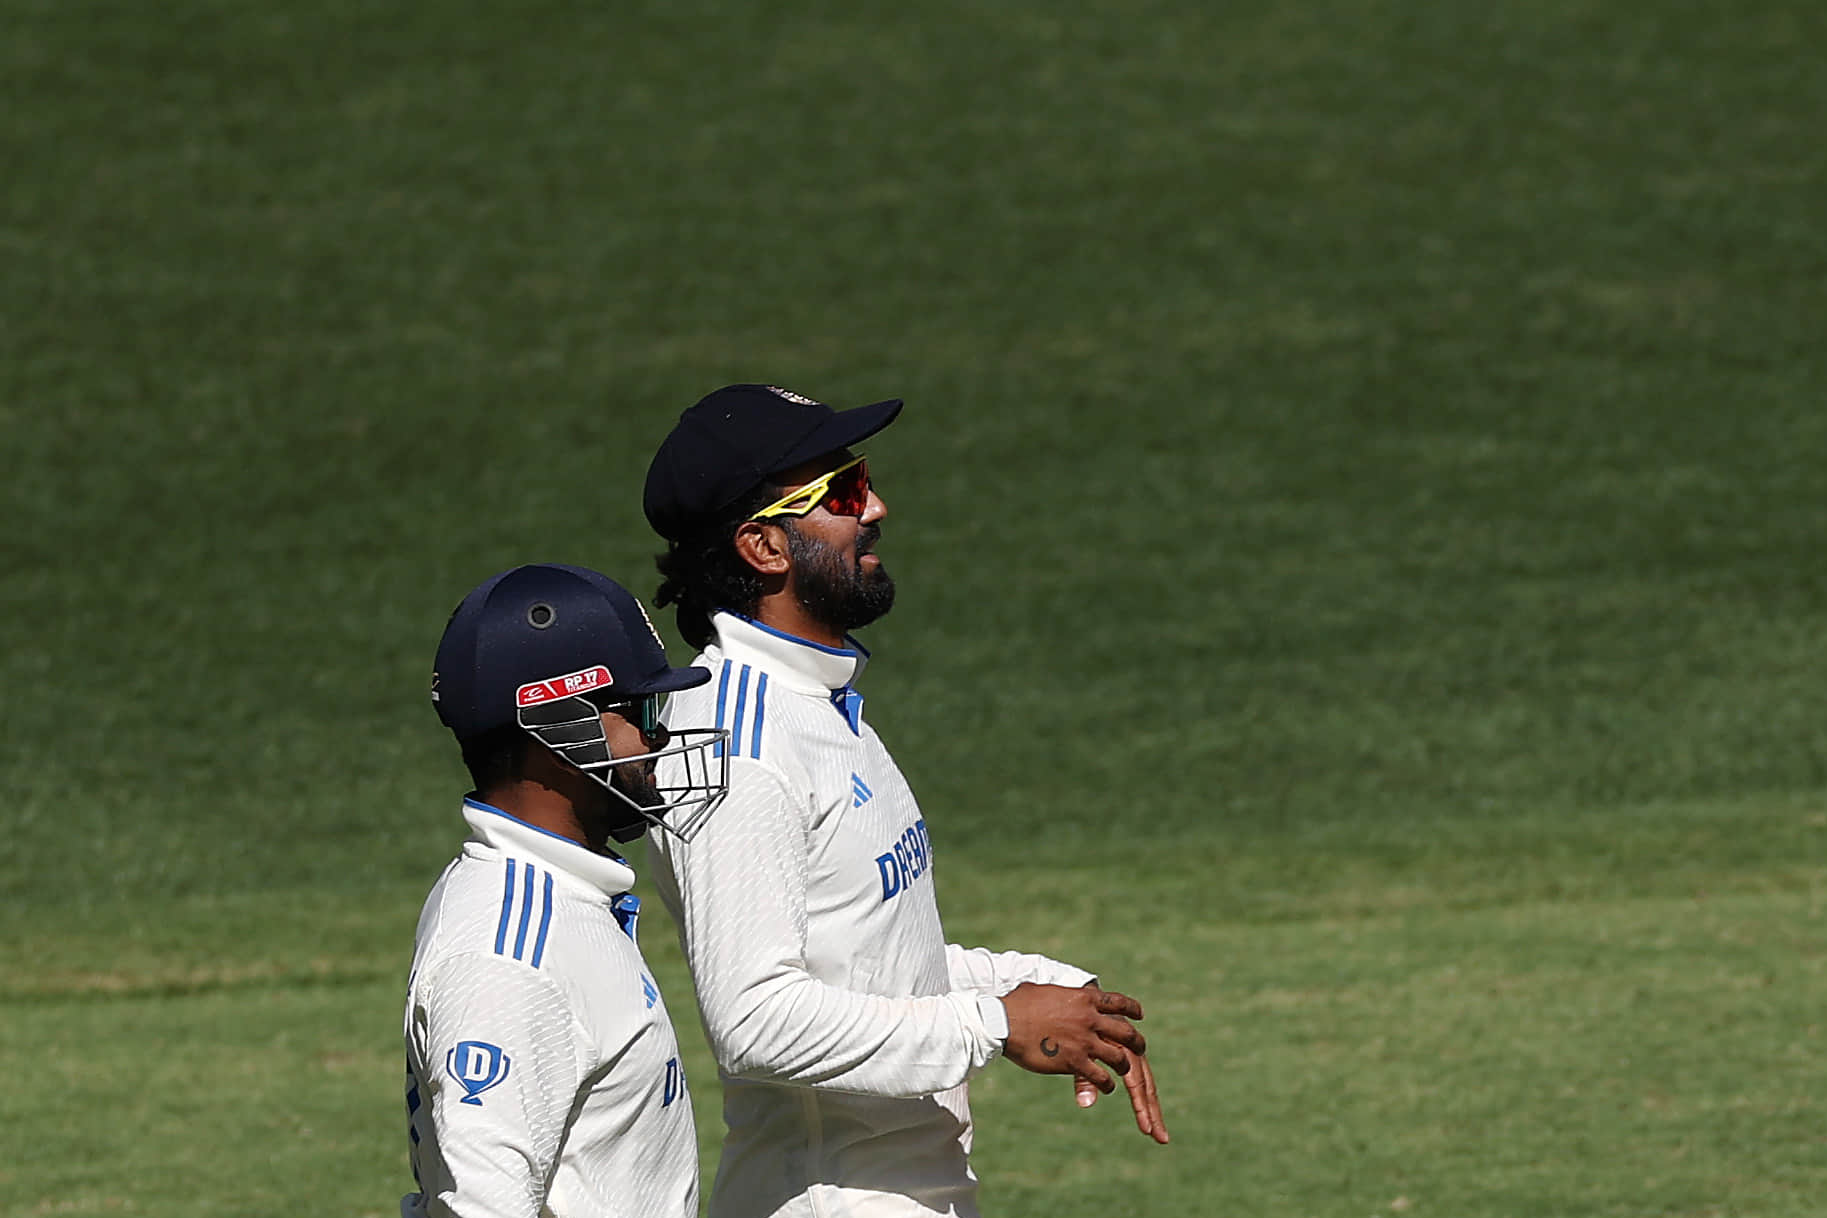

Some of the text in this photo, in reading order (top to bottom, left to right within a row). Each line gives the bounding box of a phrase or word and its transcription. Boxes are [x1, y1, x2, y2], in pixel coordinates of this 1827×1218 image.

[564, 675, 582, 690] RP
[583, 670, 598, 684] 17
[463, 1045, 493, 1082] D
